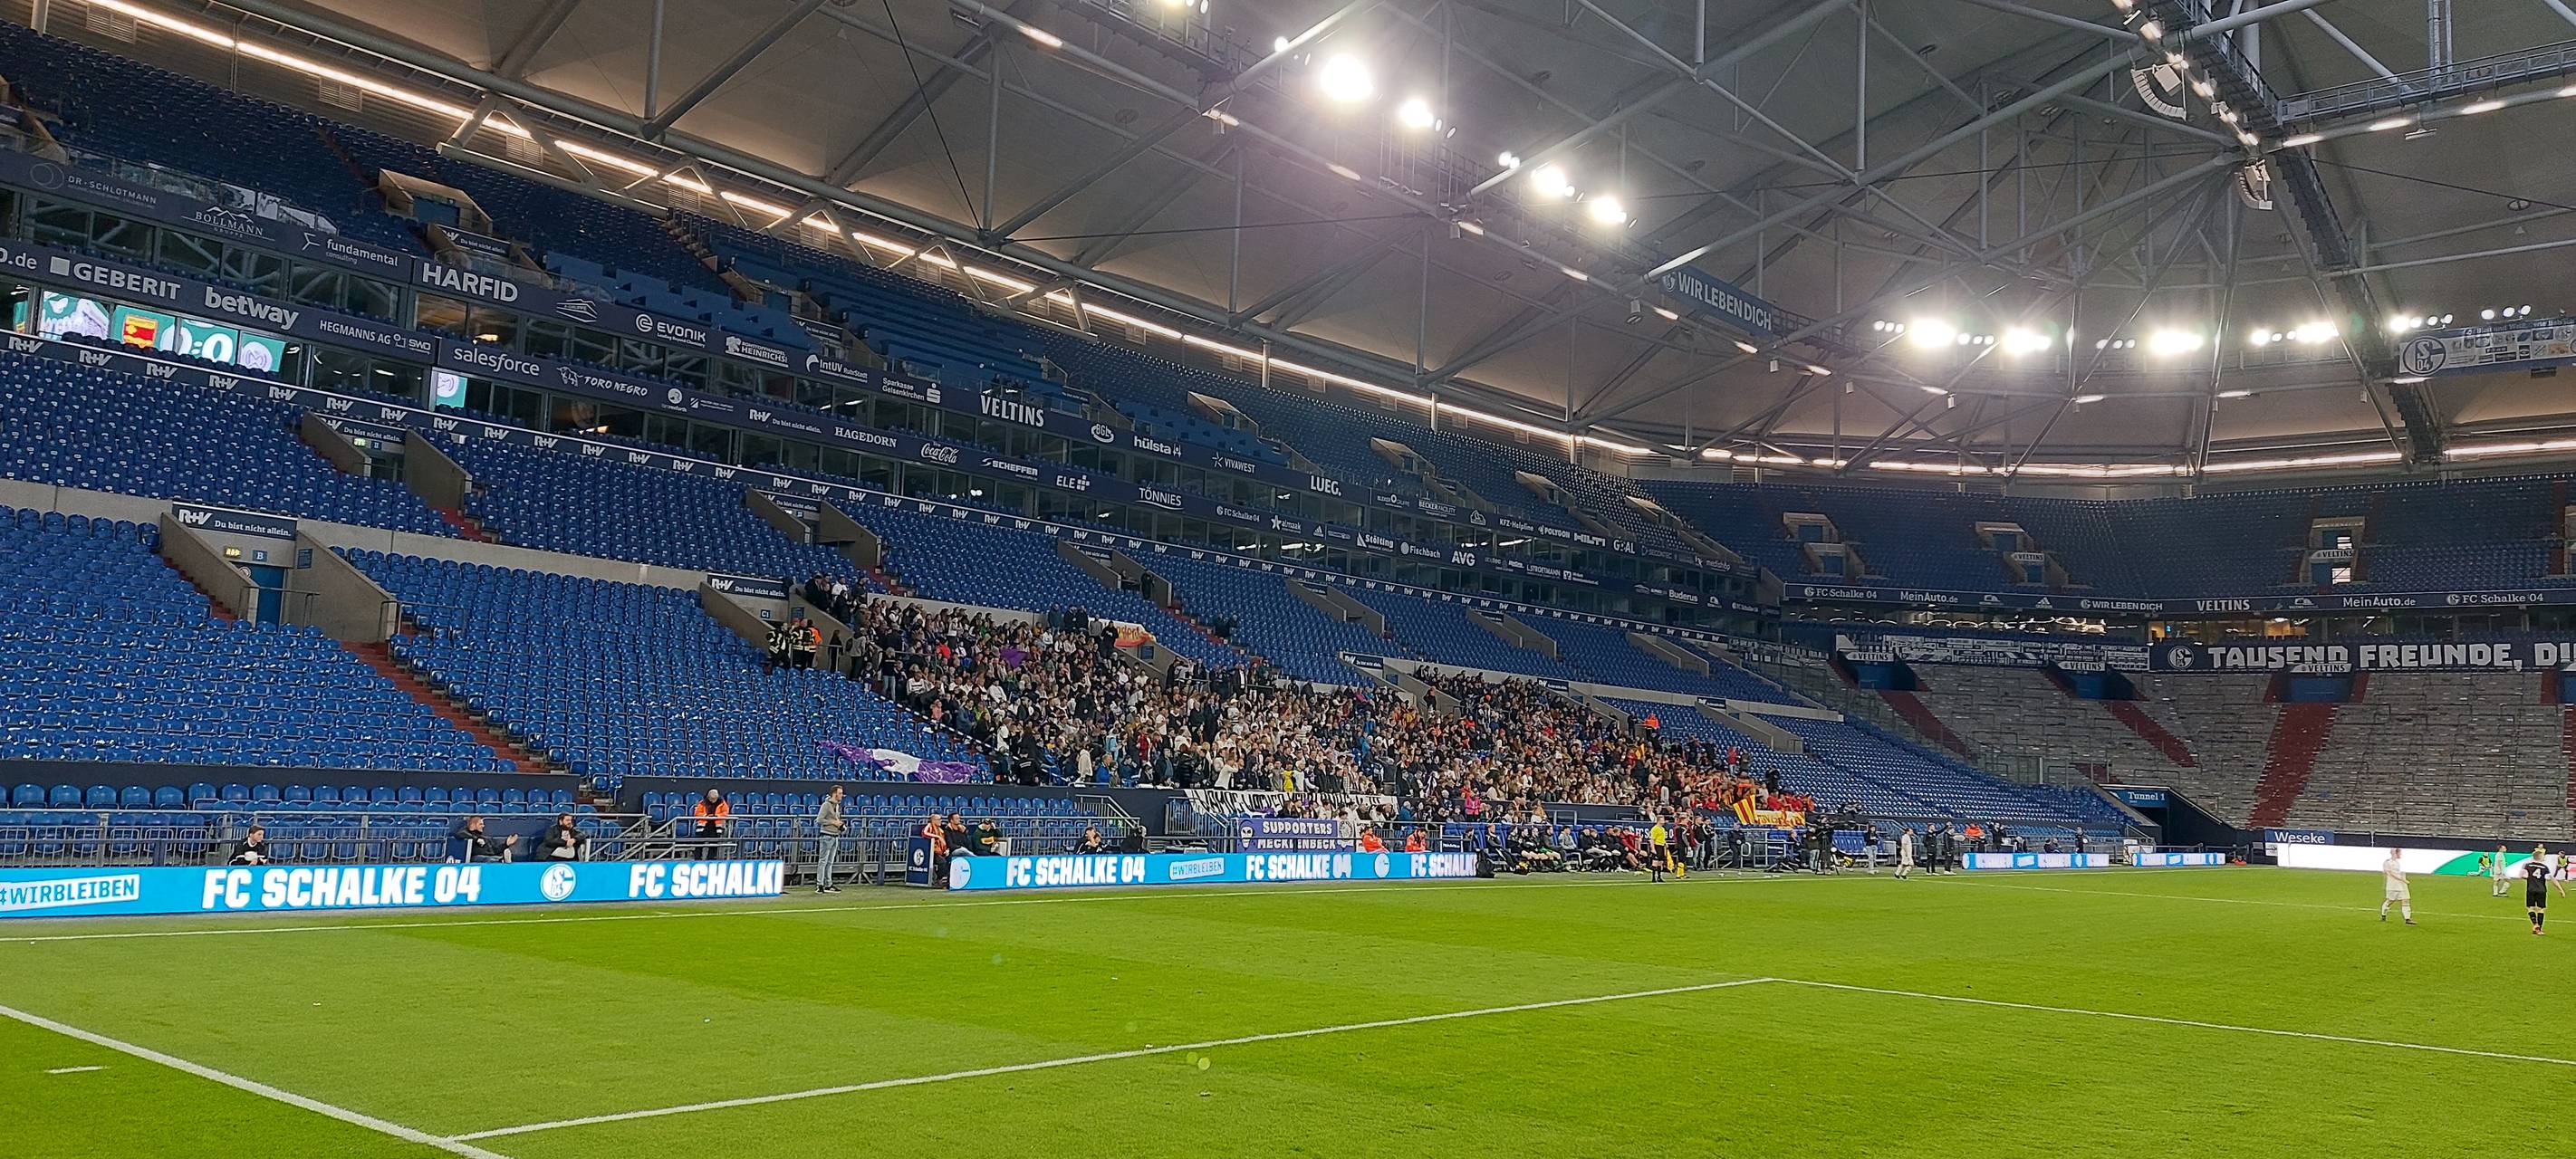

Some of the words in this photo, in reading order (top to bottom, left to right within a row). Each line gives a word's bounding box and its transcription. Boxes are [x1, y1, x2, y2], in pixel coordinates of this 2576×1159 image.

[89, 181, 157, 204] SCHLOTMANN
[196, 210, 264, 236] BOLLMANN
[326, 239, 399, 266] fundamental
[326, 251, 358, 264] consulting
[73, 263, 181, 301] GEBERIT
[422, 263, 518, 302] HARFID
[205, 286, 299, 330] betway
[1678, 272, 1704, 300] WIR
[1704, 284, 1744, 317] LEBEN
[1745, 304, 1772, 331] DICH
[320, 320, 376, 341] HEGMANNS
[377, 332, 391, 345] AG
[657, 321, 706, 343] EVONIK
[8, 336, 43, 354] R+V
[80, 350, 112, 367] R+V
[454, 348, 540, 376] salesforce
[741, 346, 785, 363] HEINRICHS
[147, 362, 178, 378] R+V
[208, 374, 240, 391] R+V
[584, 376, 611, 391] TORO
[613, 382, 648, 397] NEGRO
[882, 378, 915, 391] Sparkasse
[269, 387, 297, 401] R+V
[882, 385, 925, 401] Gelsenkirchen
[326, 397, 353, 411] R+V
[980, 394, 1044, 427] VELTINS
[749, 408, 772, 423] R+V
[781, 419, 792, 427] bist
[353, 426, 367, 436] bist
[367, 429, 382, 440] nicht
[382, 433, 402, 443] allein.
[834, 426, 897, 448] HAGEDORN
[1134, 436, 1172, 455] hülsta
[1225, 457, 1256, 474] VIVAWEST
[1056, 475, 1075, 489] ELE
[1311, 474, 1341, 497] LUEG.
[1139, 484, 1182, 507] TÖNNIES
[178, 509, 212, 525] R+V
[215, 520, 226, 528] Du
[228, 521, 245, 531] bist
[245, 523, 265, 533] nicht
[266, 526, 292, 537] allein.
[1225, 508, 1232, 517] FC
[1232, 509, 1253, 522] Schalke
[1253, 514, 1260, 522] 04
[1499, 518, 1534, 532] KFZ-Helpline
[1544, 527, 1571, 539] POLYGON
[1365, 534, 1394, 549] Stölting
[256, 551, 264, 560] B
[1409, 543, 1441, 559] Fischbach
[1451, 551, 1475, 567] AVG
[712, 578, 734, 590] R+V
[744, 586, 754, 594] bist
[755, 588, 768, 596] nicht
[769, 589, 786, 598] allein.
[1668, 589, 1698, 602] Buderus
[1830, 589, 1864, 599] Schalke
[1900, 591, 1958, 603] MeinAuto.de
[2092, 600, 2110, 608] WIR
[2111, 601, 2139, 610] LEBEN
[2140, 602, 2163, 611] DICH
[2196, 599, 2250, 611] VELTINS
[2343, 596, 2416, 607] MeinAuto.de
[2462, 595, 2477, 604] FC
[2481, 593, 2525, 603] Schalke
[2529, 593, 2544, 603] 04
[1859, 652, 1889, 661] VELTINS
[2207, 645, 2349, 670] TAUSEND
[2360, 643, 2523, 672] FREUNDE,
[2533, 641, 2576, 667] DI
[2071, 661, 2102, 671] VELTINS
[2308, 664, 2345, 673] VELTINS
[2128, 791, 2158, 800] Tunnel
[1263, 819, 1332, 835] SUPPORTERS
[2275, 830, 2325, 844] Weseke
[1006, 857, 1032, 886] FC
[1035, 856, 1118, 886] SCHALKE
[1120, 856, 1145, 883] 04
[1173, 861, 1222, 876] #WIRBLEIBEN
[1246, 855, 1265, 880] FC
[1268, 854, 1331, 880] SCHALKE
[1333, 854, 1353, 878] 04
[1411, 854, 1427, 877] FC
[2532, 868, 2542, 878] 4
[202, 868, 254, 909] FC
[261, 866, 426, 909] SCHALKE
[433, 866, 482, 904] 04
[629, 863, 665, 898] FC
